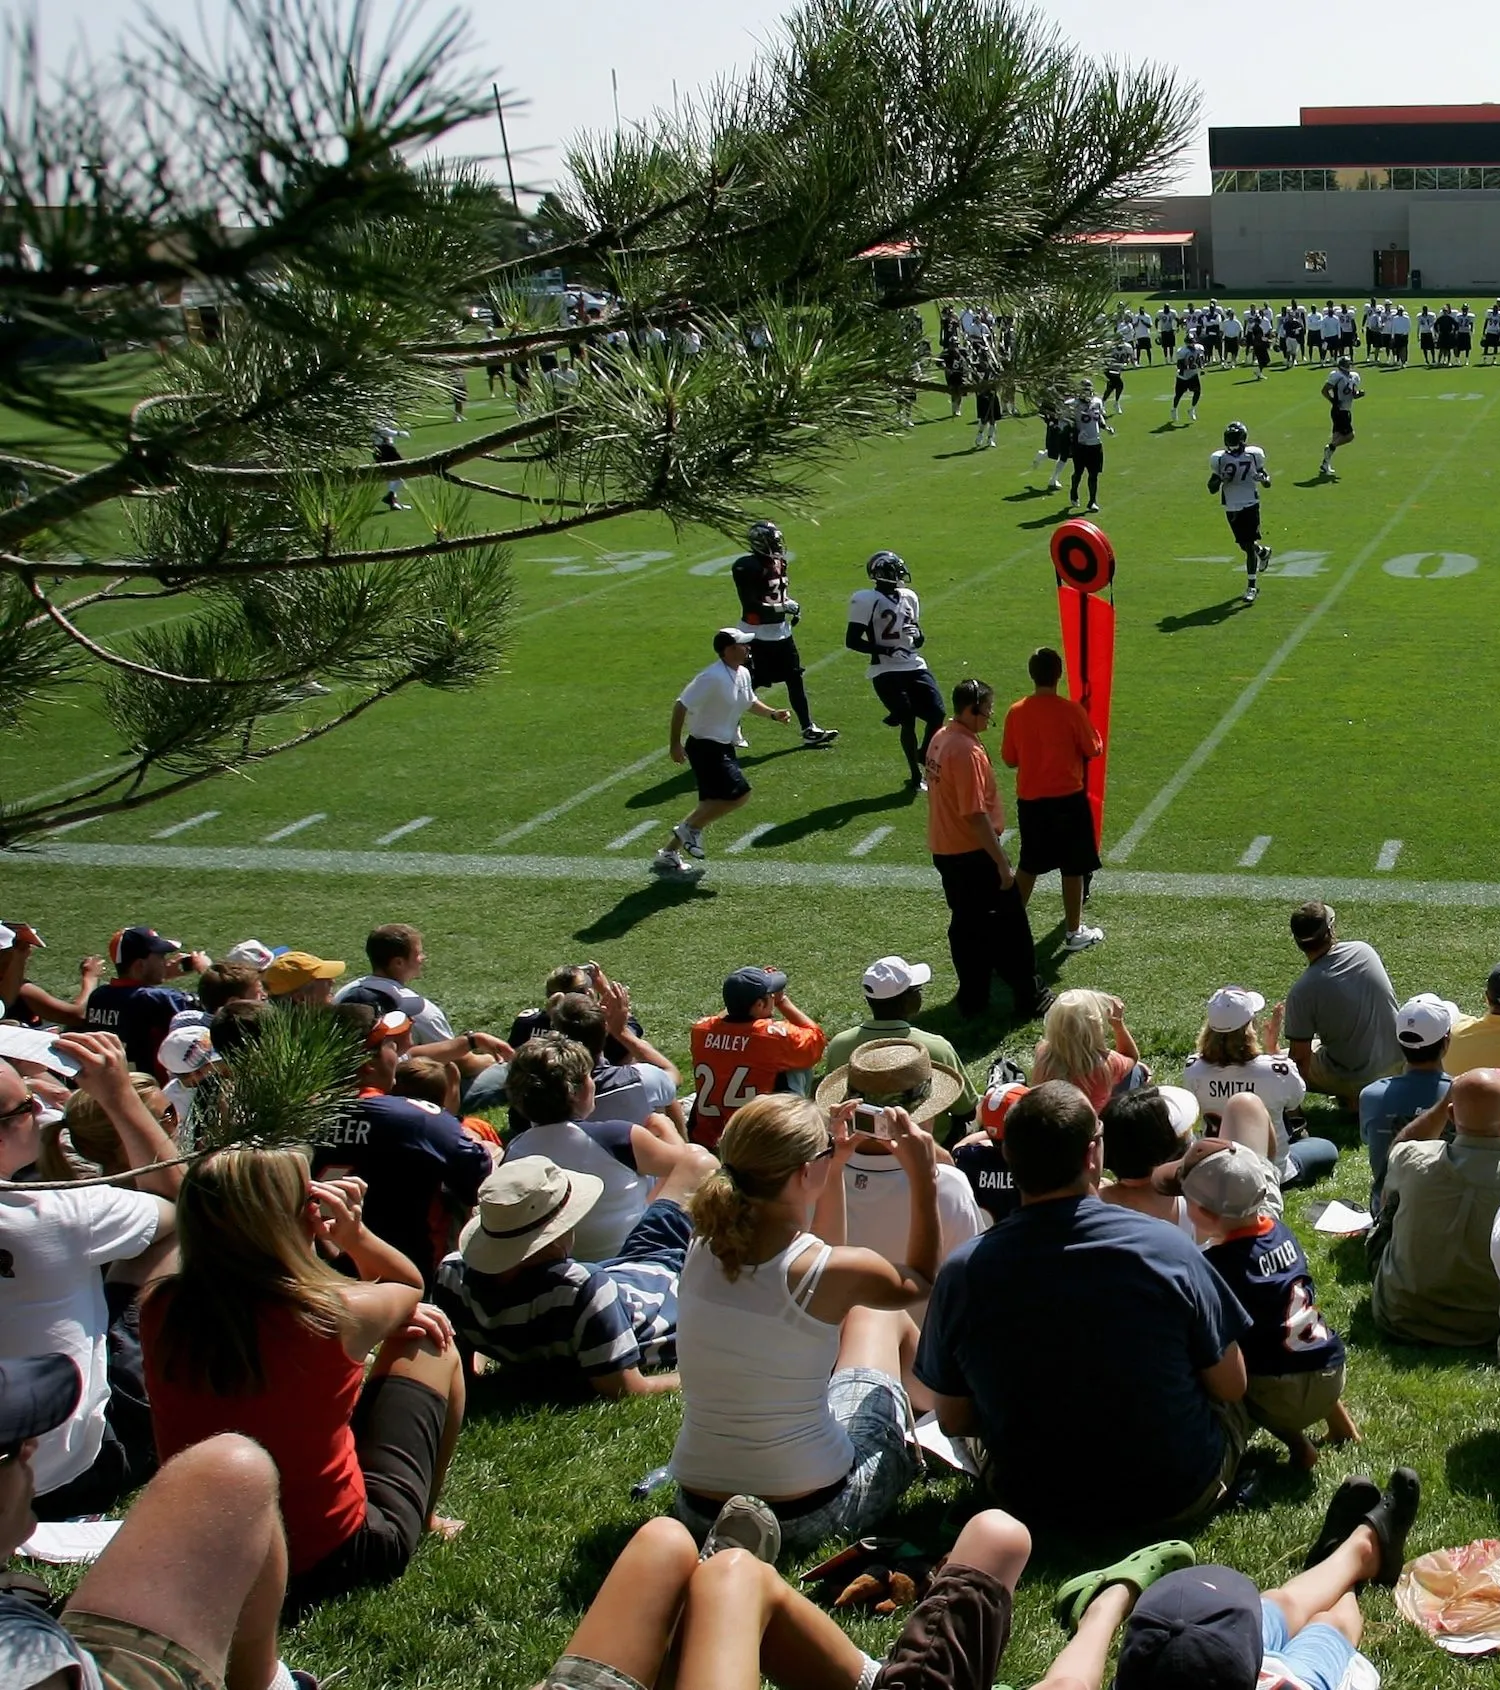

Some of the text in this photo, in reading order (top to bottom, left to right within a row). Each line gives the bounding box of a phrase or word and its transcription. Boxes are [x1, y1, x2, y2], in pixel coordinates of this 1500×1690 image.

[1224, 462, 1251, 482] 97
[704, 1033, 749, 1052] BAILEY
[695, 1063, 757, 1117] 24
[1209, 1080, 1255, 1098] SMITH
[978, 1171, 1015, 1189] BAILE
